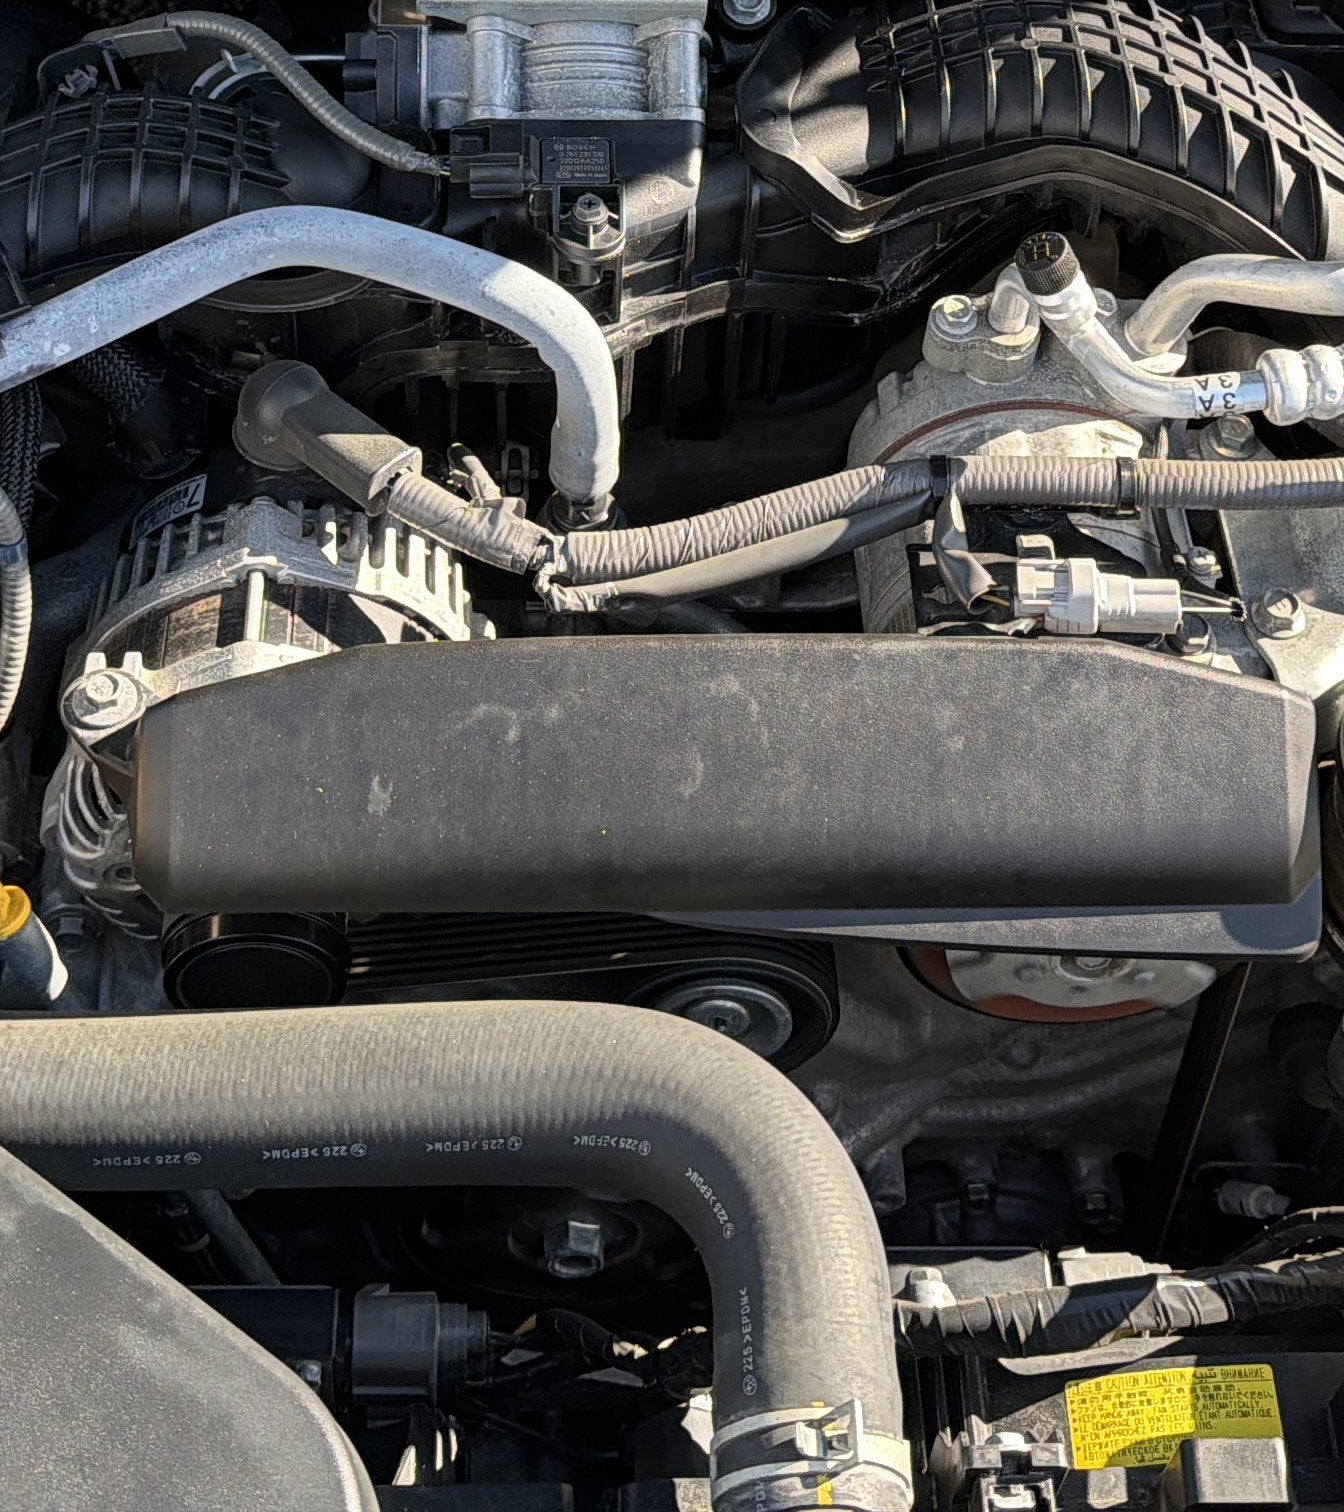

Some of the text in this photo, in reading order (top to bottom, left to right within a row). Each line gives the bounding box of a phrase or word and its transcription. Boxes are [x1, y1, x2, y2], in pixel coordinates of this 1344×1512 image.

[1198, 392, 1237, 412] 3 A
[482, 1139, 505, 1151] 225
[619, 1137, 638, 1151] 225
[322, 1146, 348, 1156] 225
[155, 1154, 181, 1165] 225
[713, 1203, 729, 1224] 225
[743, 1346, 753, 1373] 225
[1220, 1367, 1265, 1380] ВНИМАНИЕ
